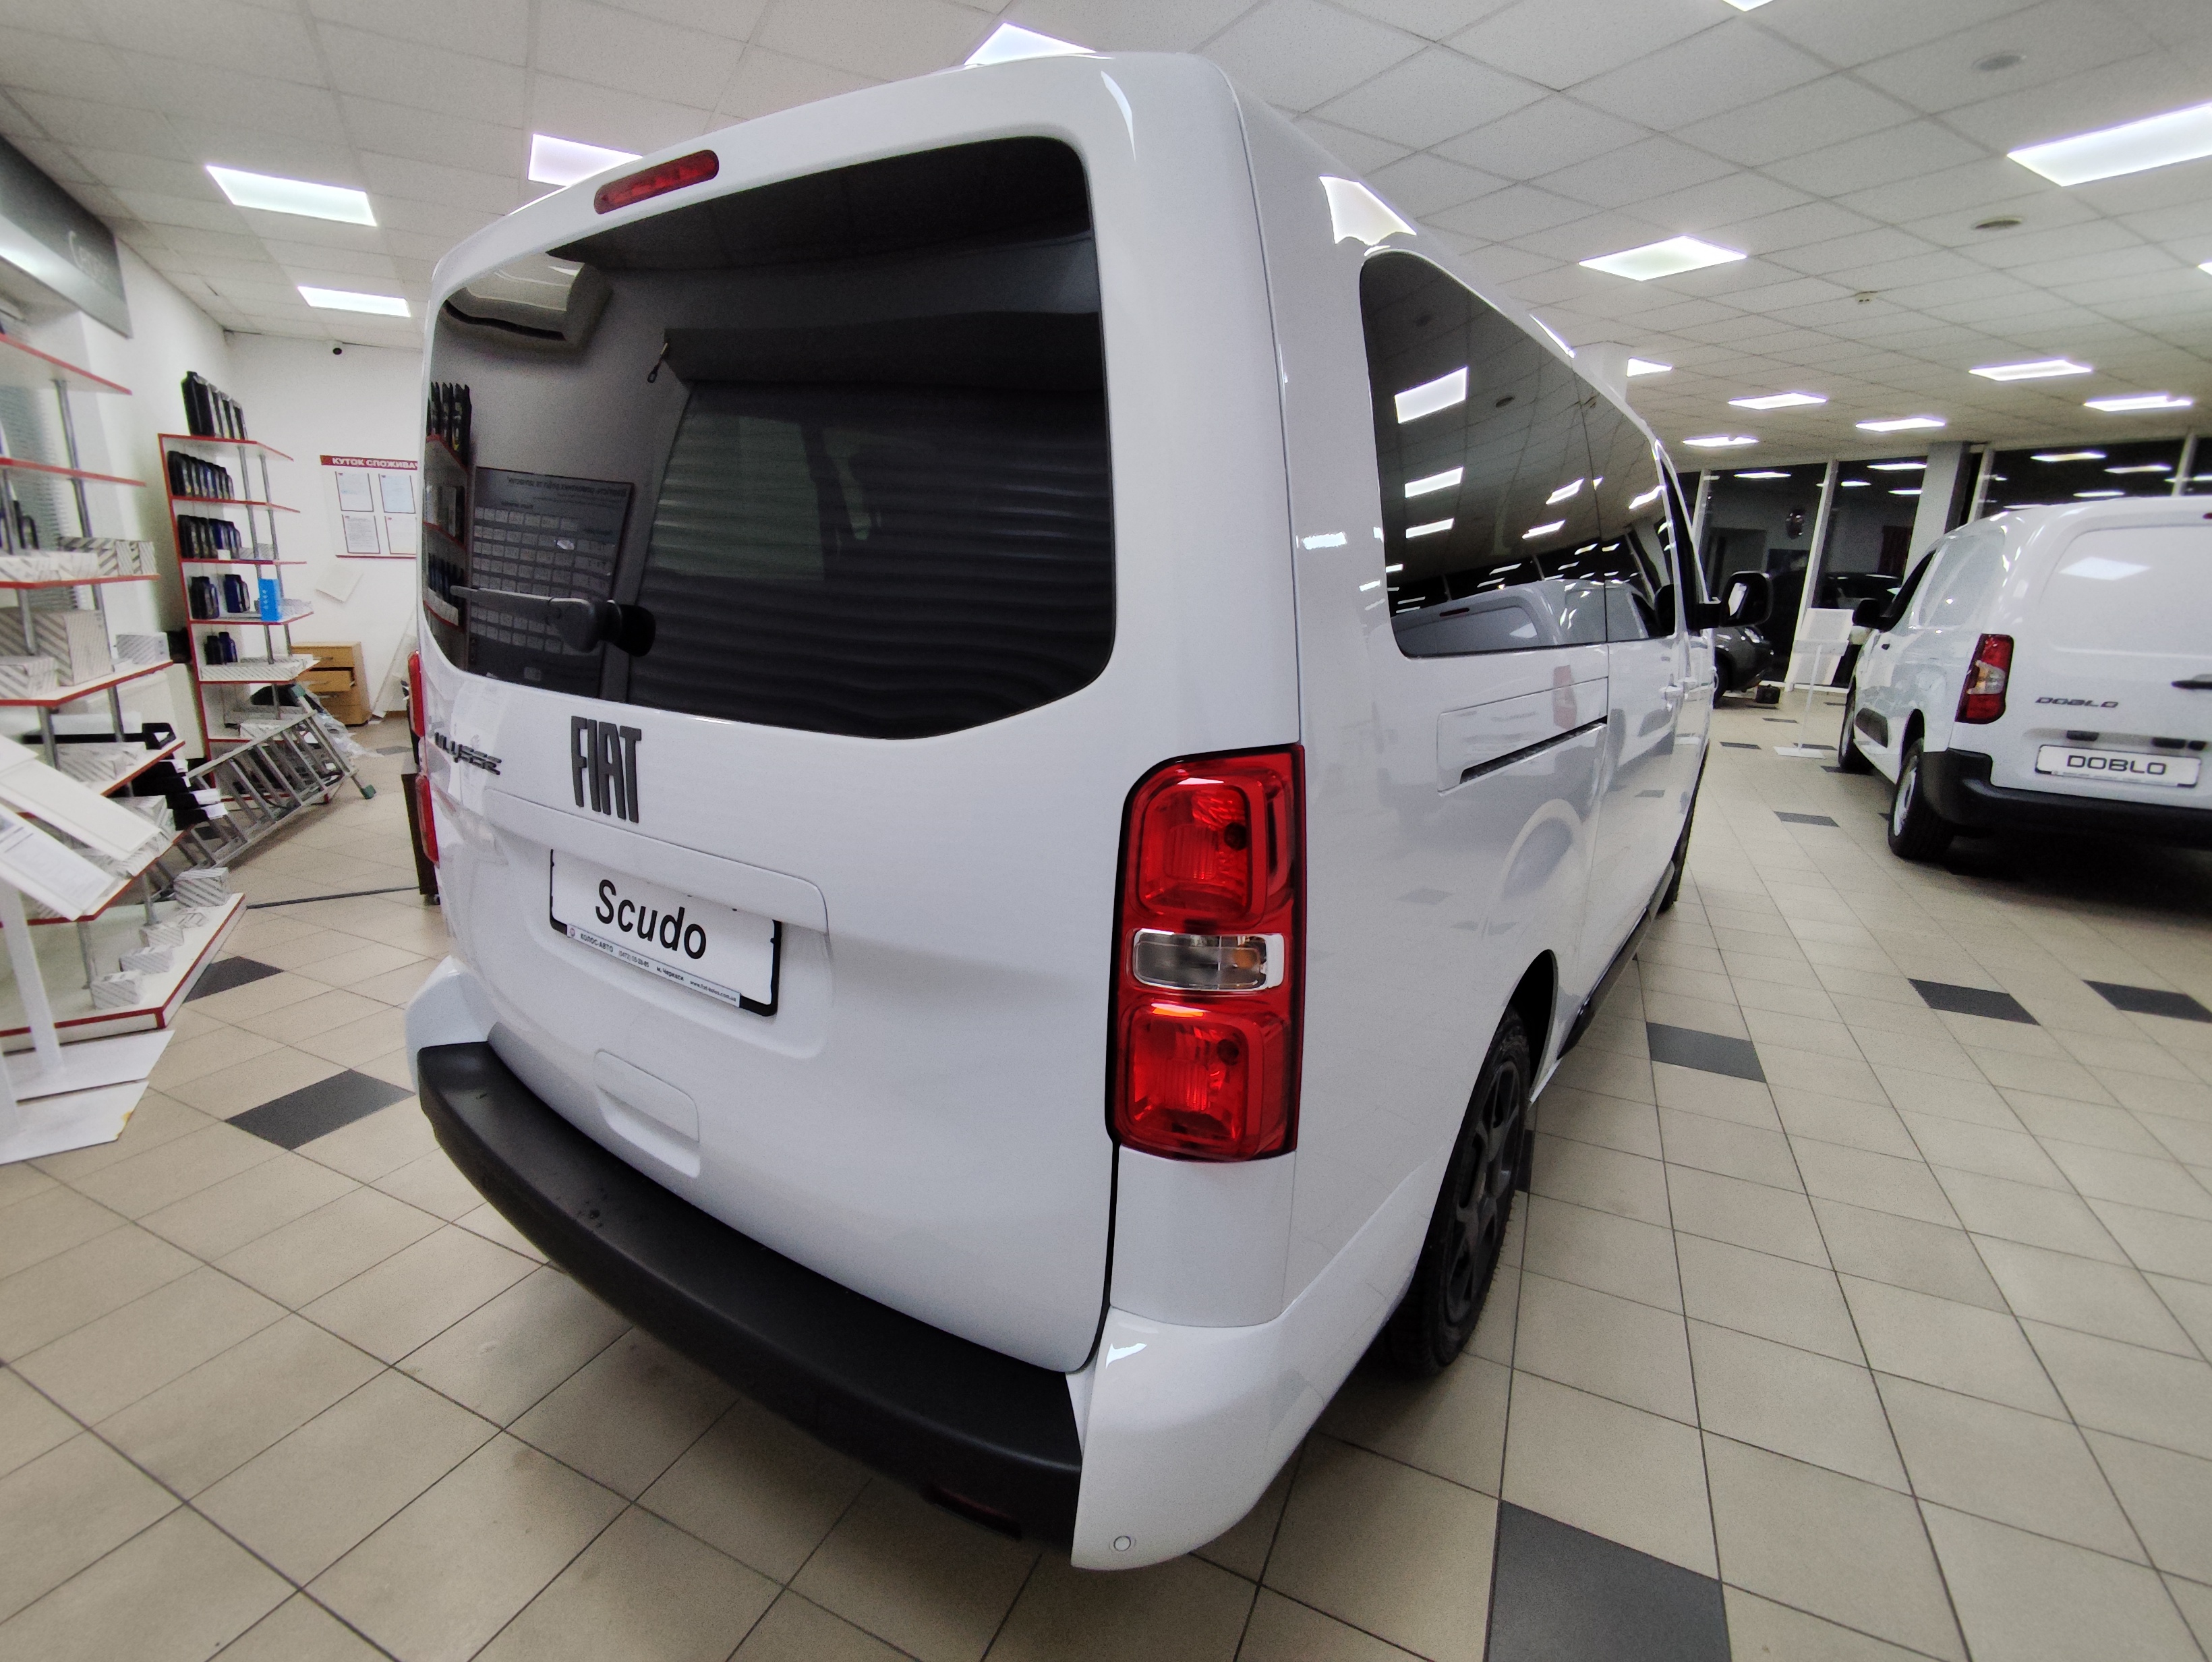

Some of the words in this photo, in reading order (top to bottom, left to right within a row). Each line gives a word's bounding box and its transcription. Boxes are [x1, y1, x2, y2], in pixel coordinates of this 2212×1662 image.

[332, 457, 365, 465] КУТОК
[2035, 697, 2119, 708] DOBLO
[571, 716, 641, 824] FIAT
[2066, 755, 2167, 775] DOBLO
[595, 880, 706, 959] Scudo
